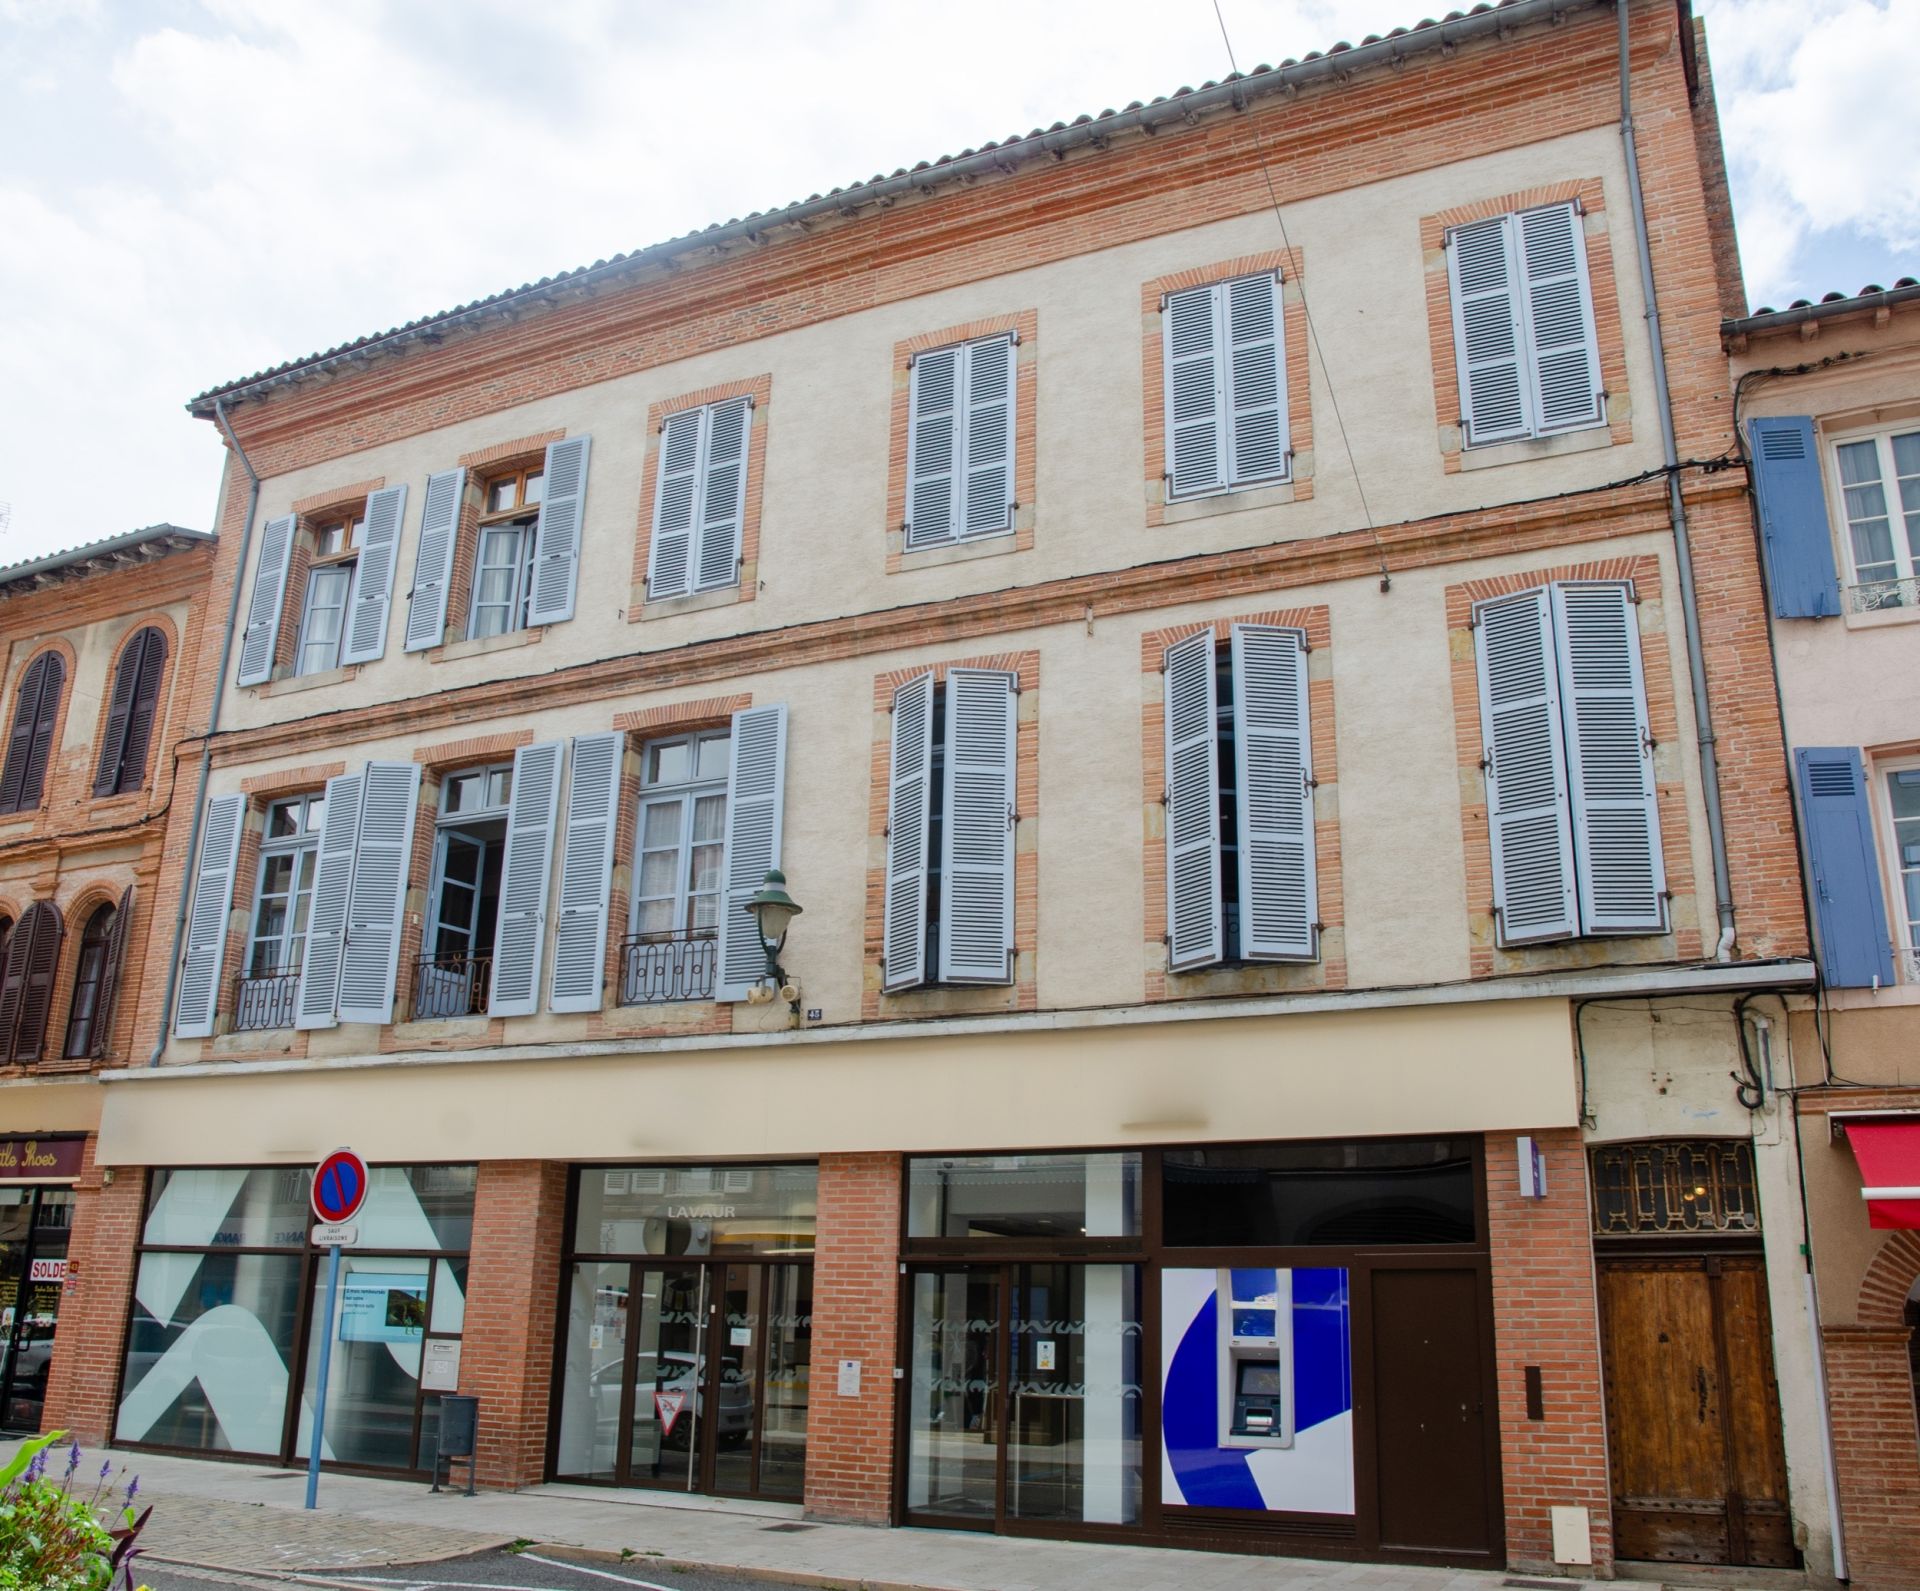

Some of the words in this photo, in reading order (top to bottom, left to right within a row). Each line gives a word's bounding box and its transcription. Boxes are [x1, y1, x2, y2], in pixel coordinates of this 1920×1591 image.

[21, 1140, 57, 1167] Shoes
[668, 1206, 736, 1218] LAVAUR
[32, 1262, 66, 1278] SOLDE
